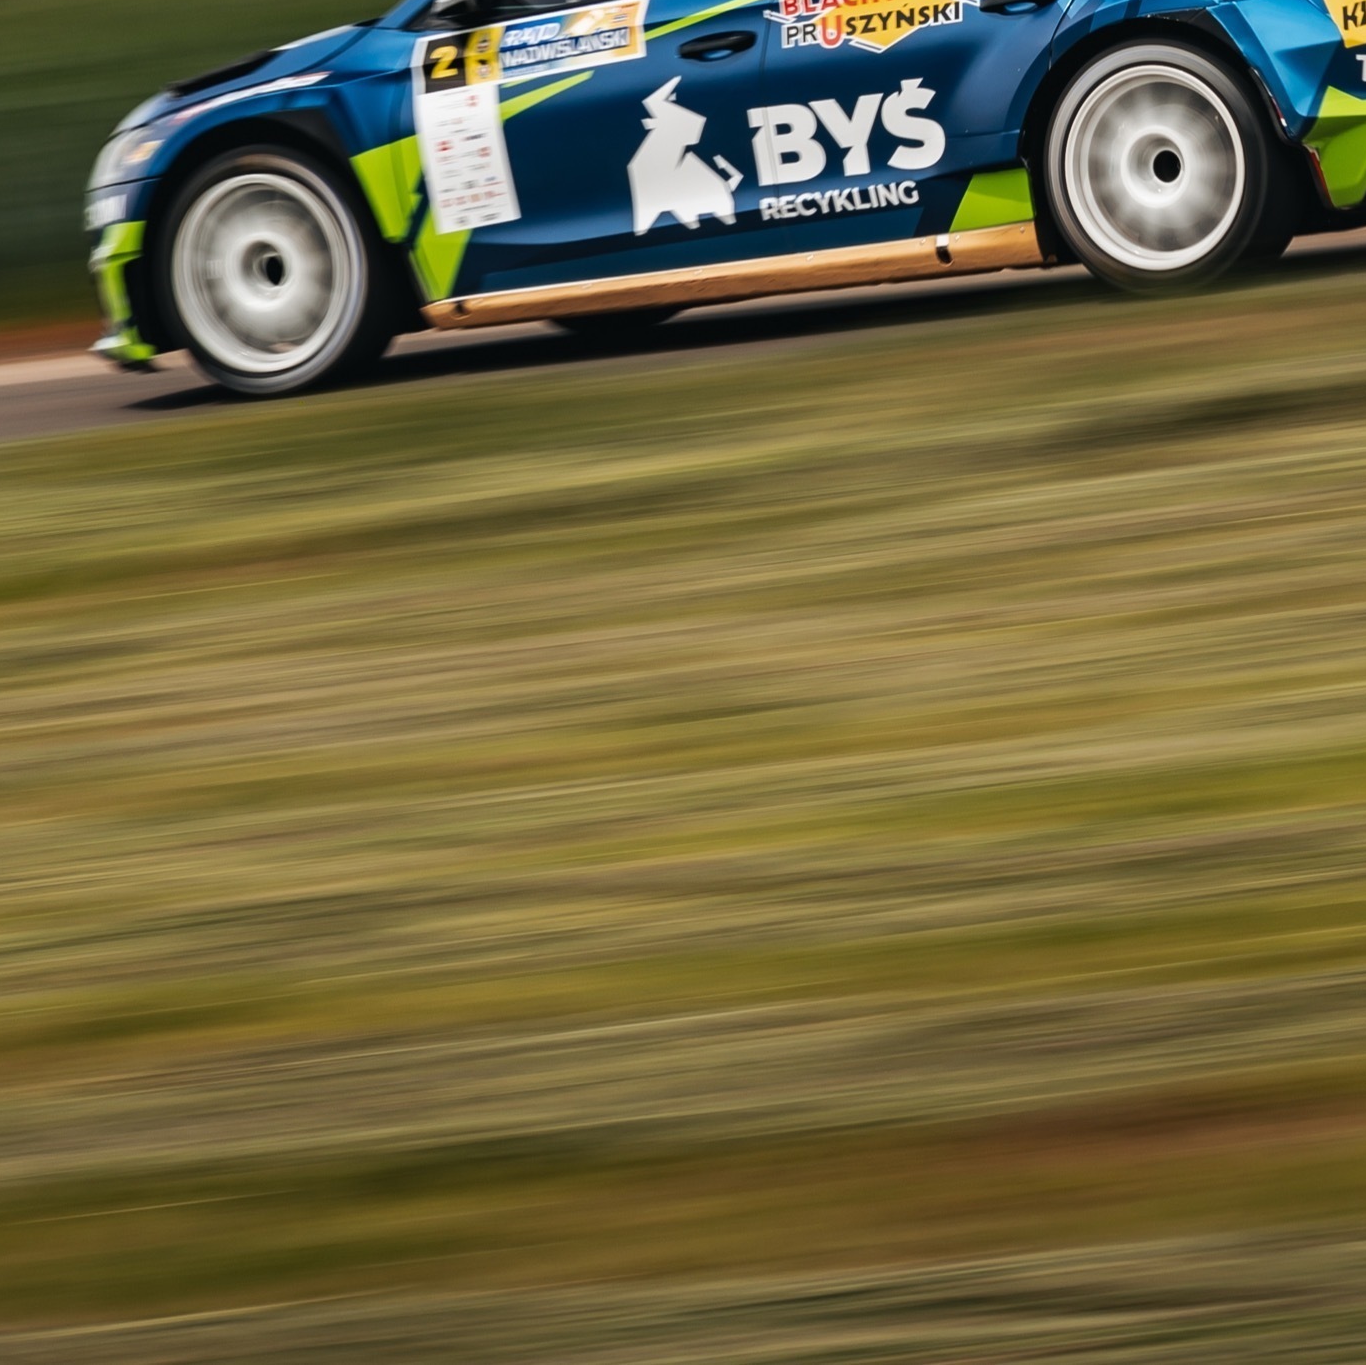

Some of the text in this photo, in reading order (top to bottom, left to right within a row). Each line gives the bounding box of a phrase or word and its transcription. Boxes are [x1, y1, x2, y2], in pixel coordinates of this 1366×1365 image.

[786, 1, 960, 47] PRUSZYŃSKI
[430, 46, 458, 79] 2
[747, 77, 946, 186] BYŚ
[759, 180, 920, 221] RECYKLING
